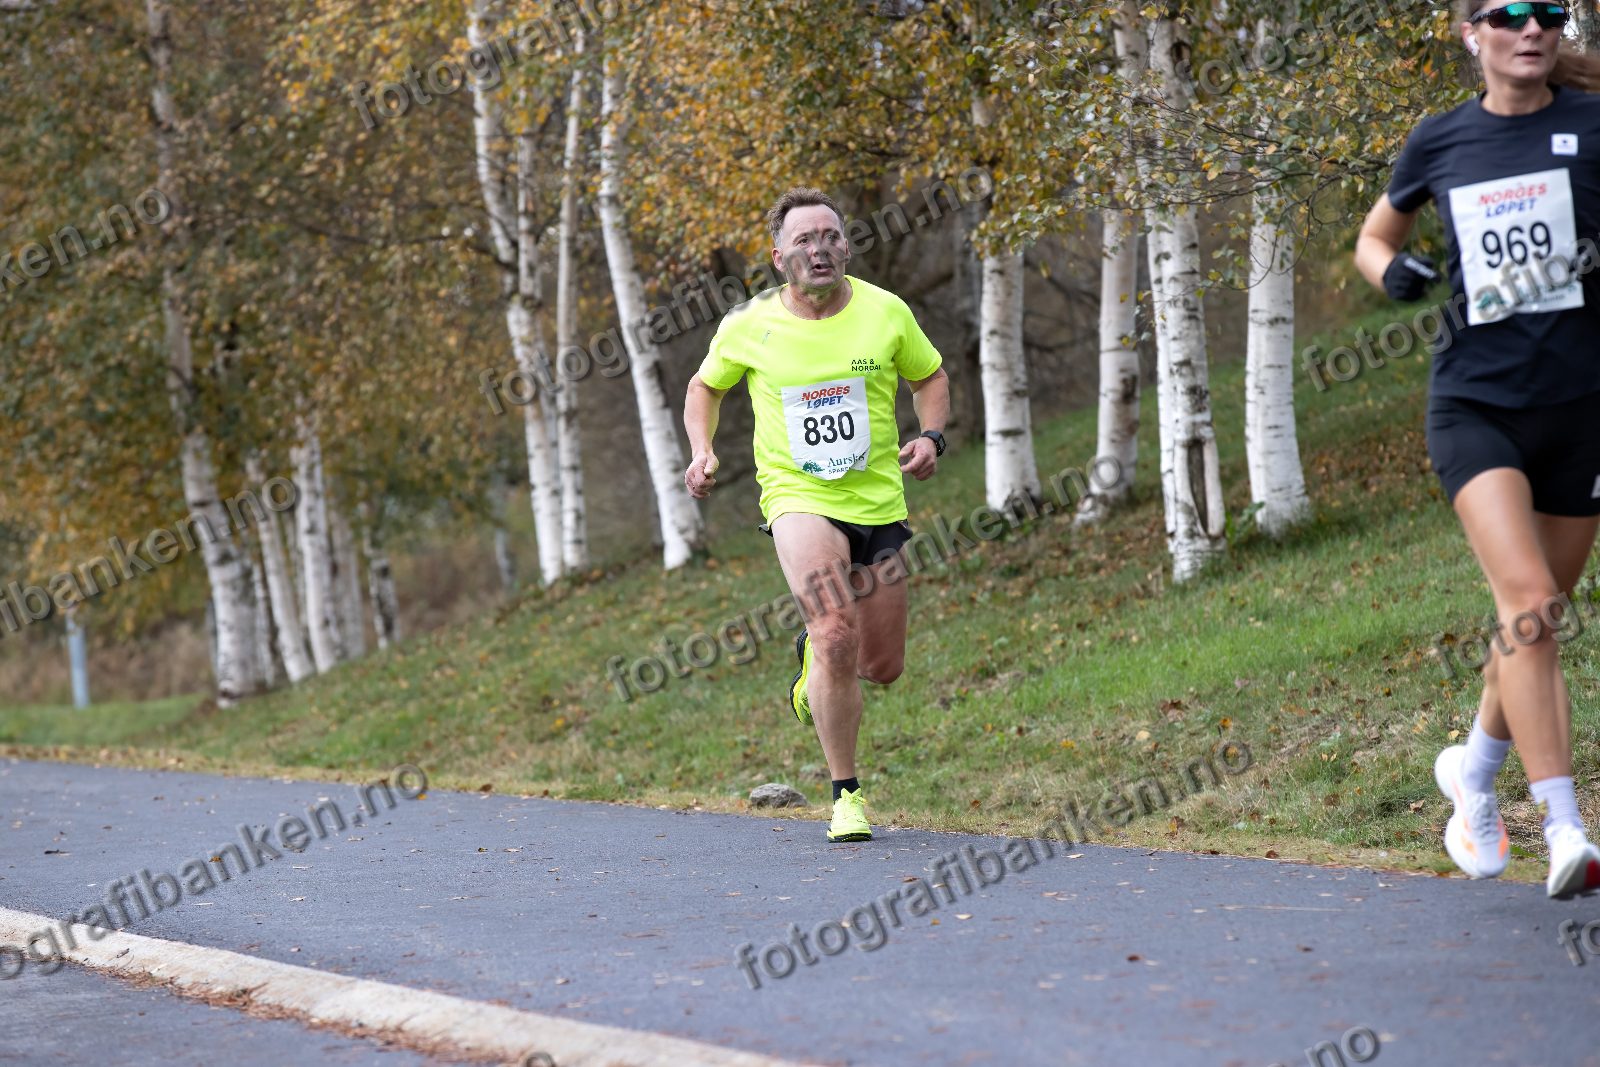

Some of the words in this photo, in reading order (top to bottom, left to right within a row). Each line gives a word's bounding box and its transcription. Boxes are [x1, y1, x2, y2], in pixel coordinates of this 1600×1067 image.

[1478, 183, 1548, 205] NORGES
[1486, 198, 1538, 218] LØPET
[1481, 220, 1553, 269] 969
[801, 385, 851, 401] NORGES
[806, 395, 844, 409] LØPET
[803, 411, 855, 446] 830
